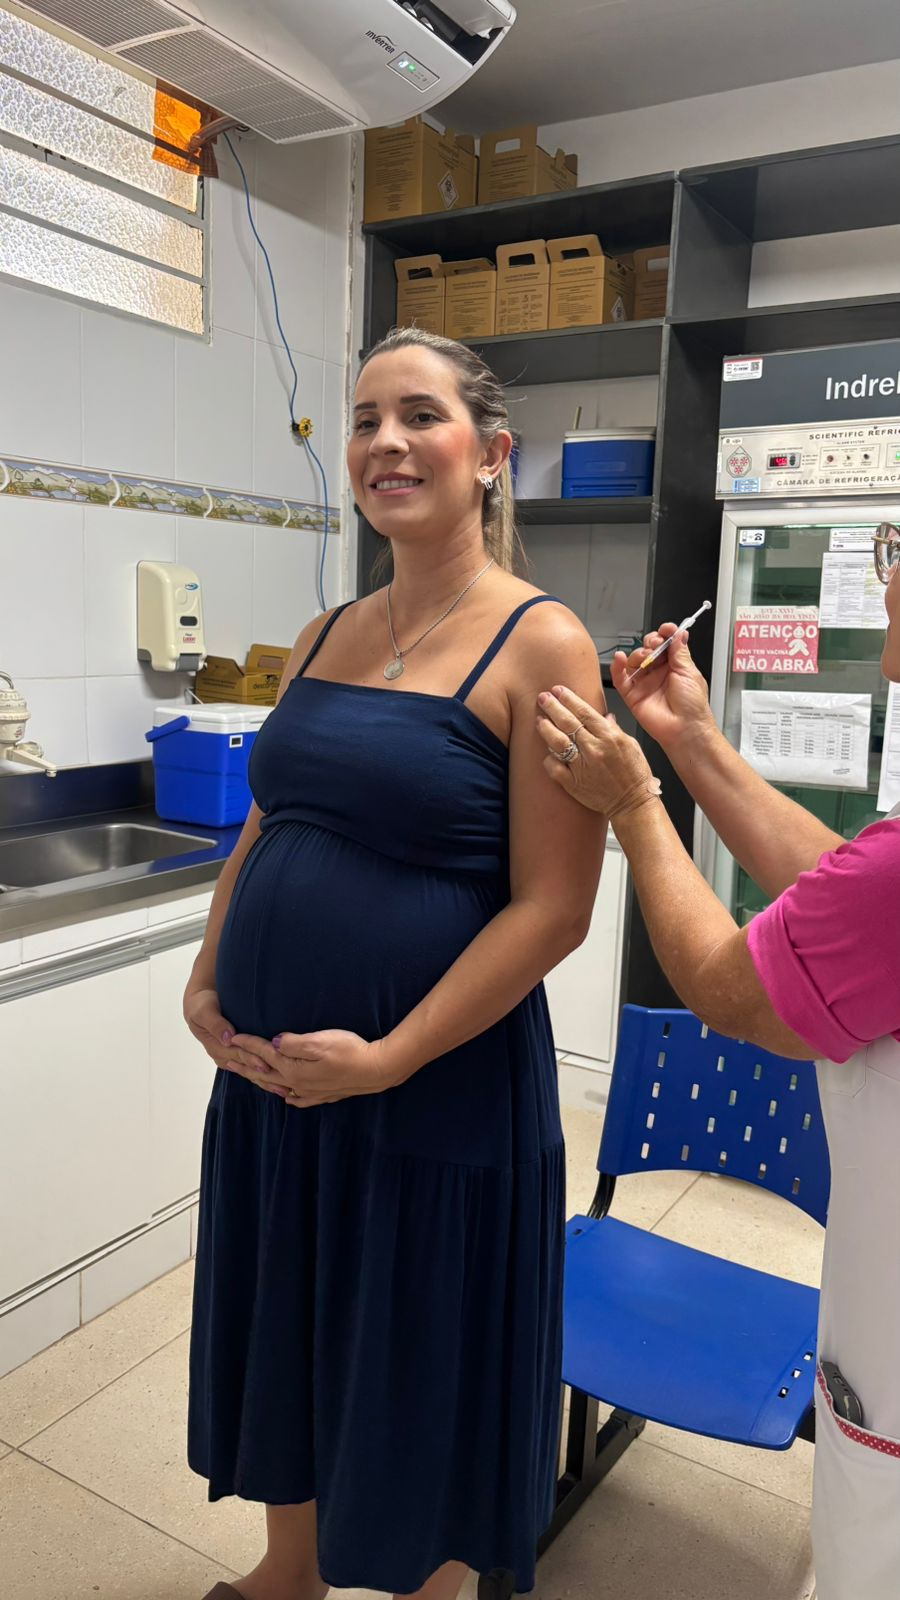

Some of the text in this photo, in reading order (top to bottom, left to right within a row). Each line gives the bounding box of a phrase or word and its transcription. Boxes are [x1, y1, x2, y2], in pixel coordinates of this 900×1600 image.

[809, 430, 865, 440] SCIENTIFIC
[776, 478, 815, 486] CÂMARA
[738, 622, 817, 643] ATENÇÃO
[736, 655, 815, 671] NÃO ABRA
